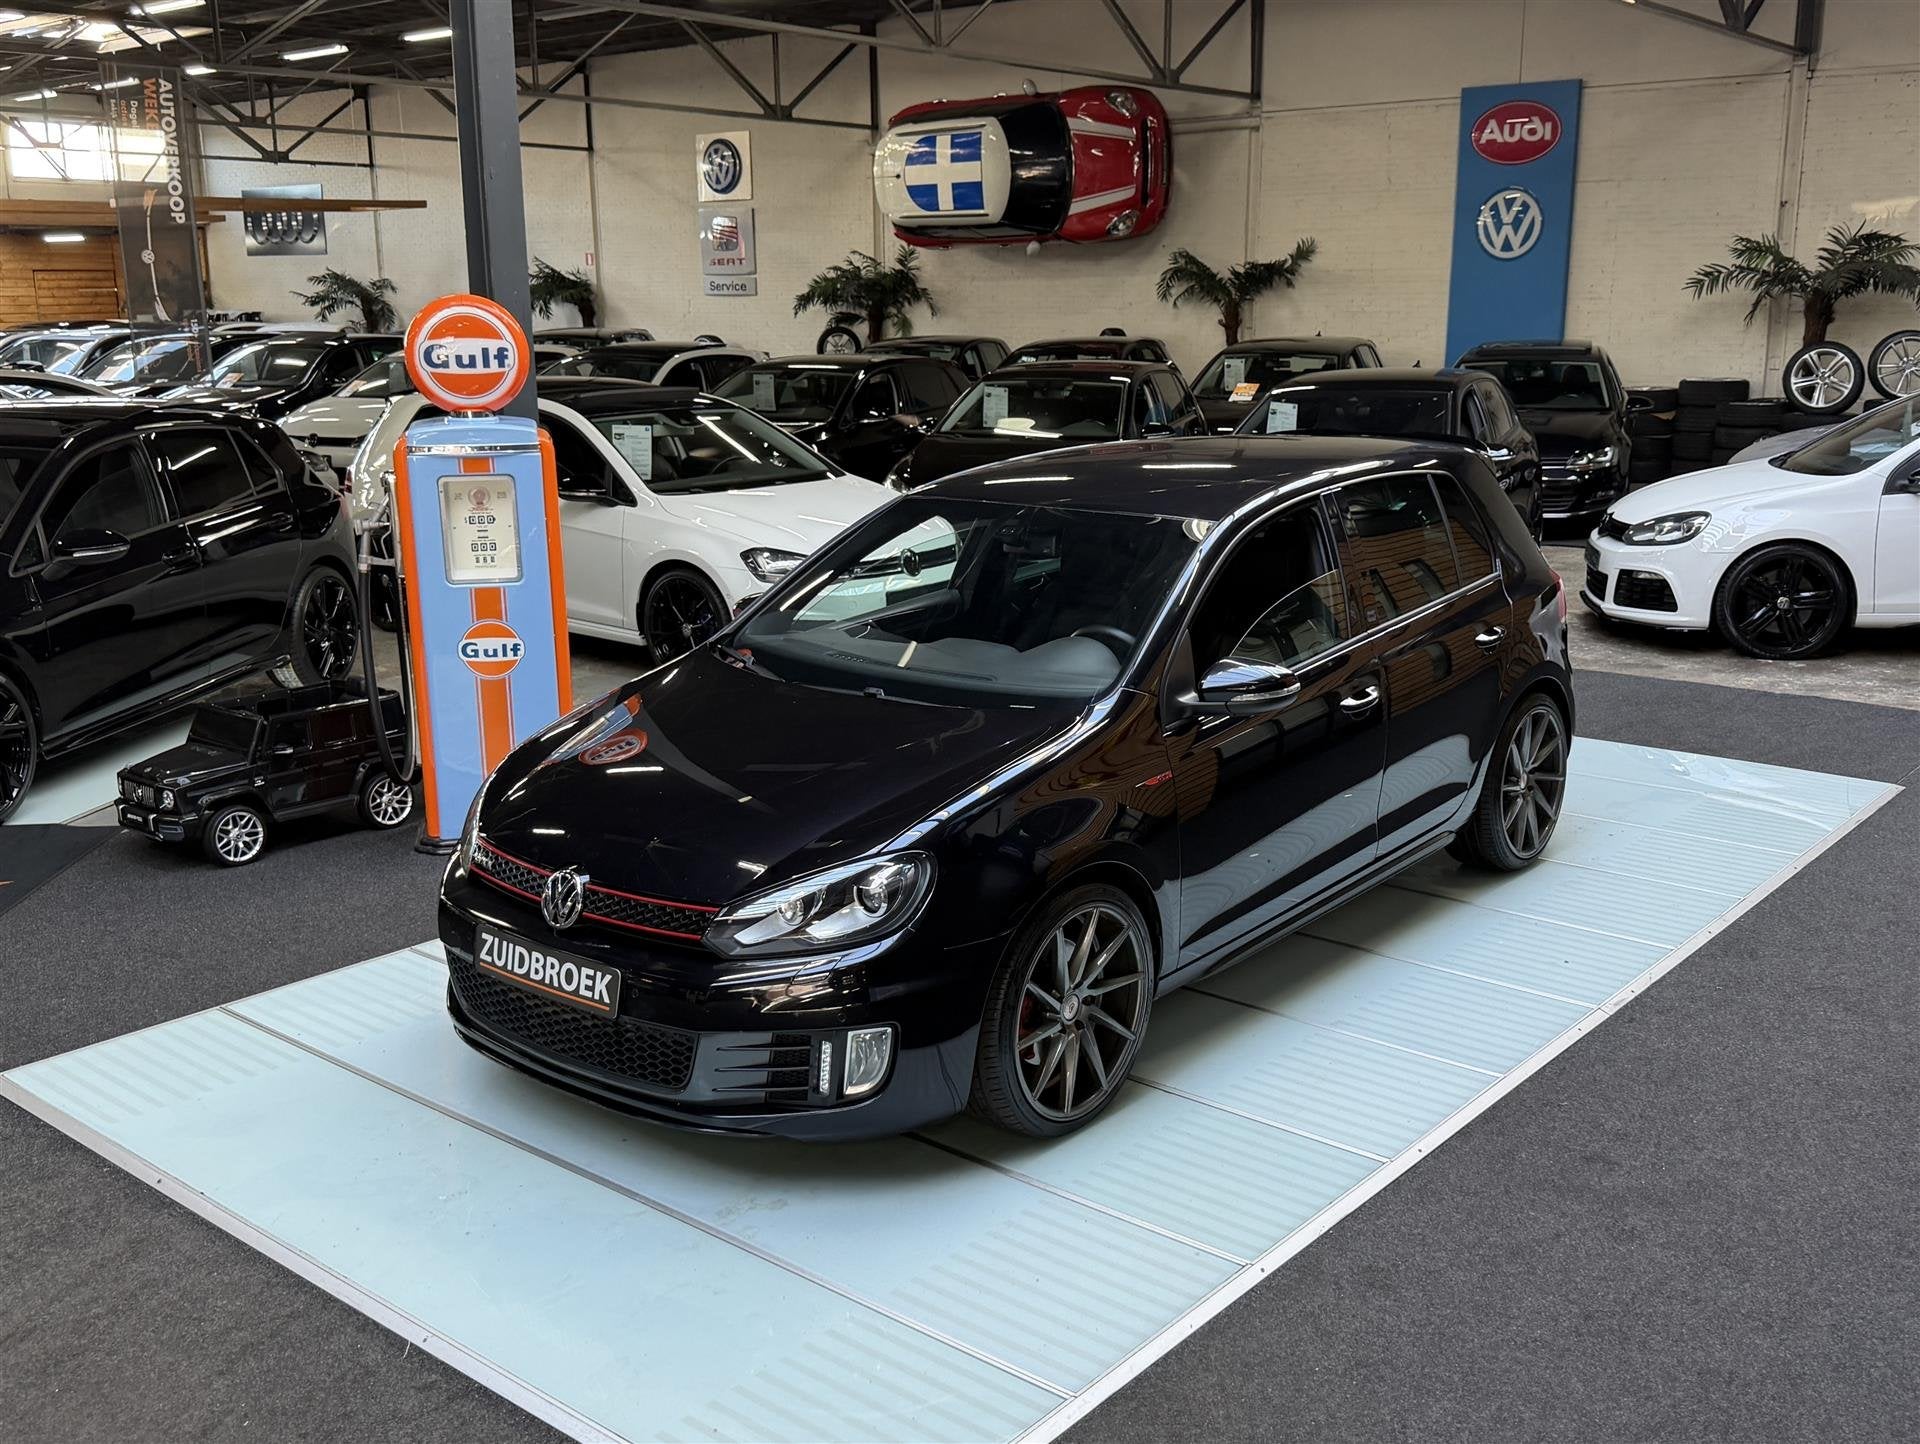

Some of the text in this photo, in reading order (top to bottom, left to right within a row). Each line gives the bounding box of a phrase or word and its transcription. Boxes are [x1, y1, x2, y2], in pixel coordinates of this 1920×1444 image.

[129, 100, 140, 128] Dagel
[143, 78, 161, 131] WEKE
[1479, 116, 1553, 144] Audi
[159, 78, 186, 224] AUTOVERKOOP
[709, 257, 746, 266] SEAT
[709, 280, 748, 292] Service
[423, 343, 509, 369] Gulf
[461, 641, 522, 658] Gulf
[479, 932, 613, 1004] ZUIDBROEK
